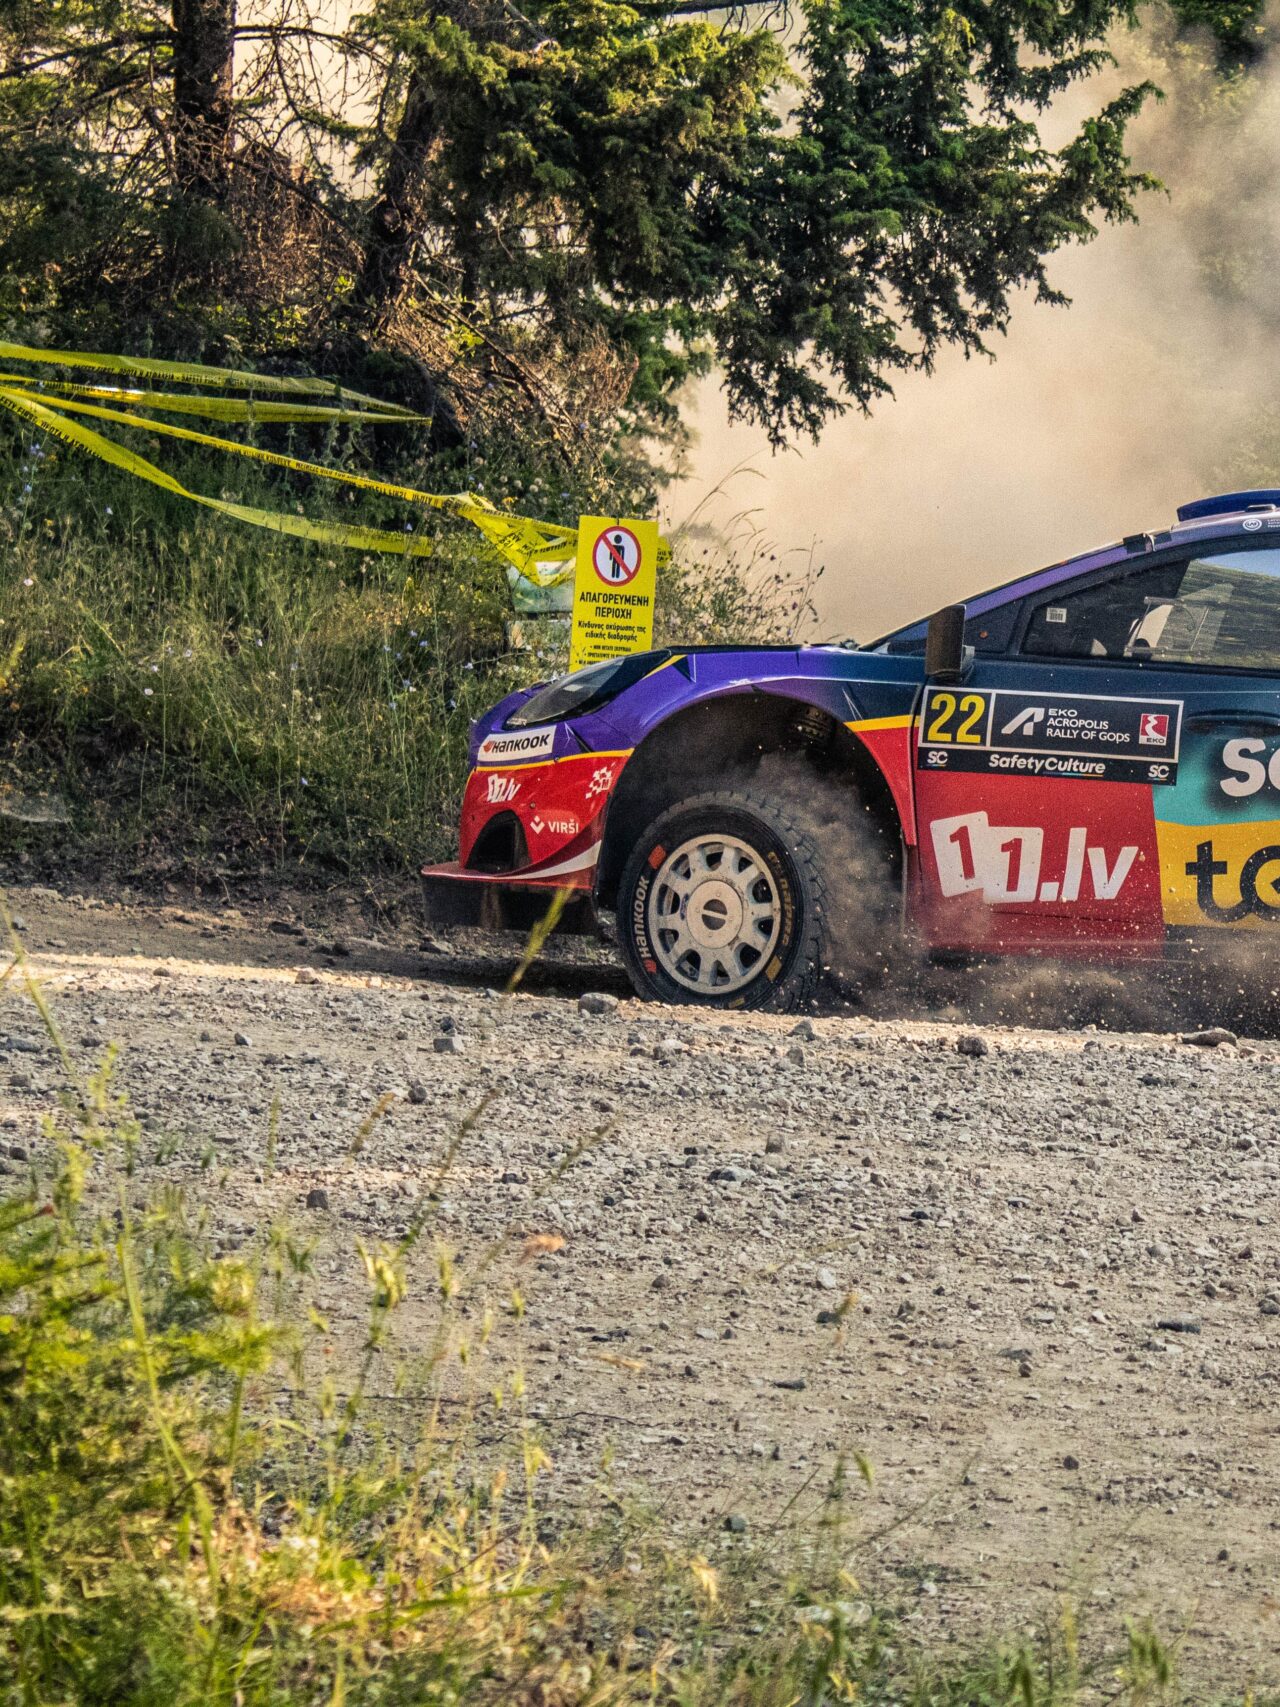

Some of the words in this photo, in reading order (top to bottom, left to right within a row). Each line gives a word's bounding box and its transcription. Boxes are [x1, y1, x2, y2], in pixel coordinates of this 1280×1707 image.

[580, 592, 649, 607] ΑΠΑΓΟΡΕΥΜΕΝΗ
[595, 607, 632, 619] ΠΕΡΙΟΧΗ
[927, 693, 985, 744] 22
[1048, 708, 1078, 717] EKO
[1047, 717, 1109, 730] ACROPOLIS
[1046, 728, 1079, 739] RALLY
[1081, 730, 1097, 740] OF
[1098, 731, 1131, 744] GODS
[927, 750, 948, 765] SC
[989, 753, 1106, 774] SafetyCulture
[1147, 764, 1170, 778] SC
[548, 819, 579, 834] VIRŠI
